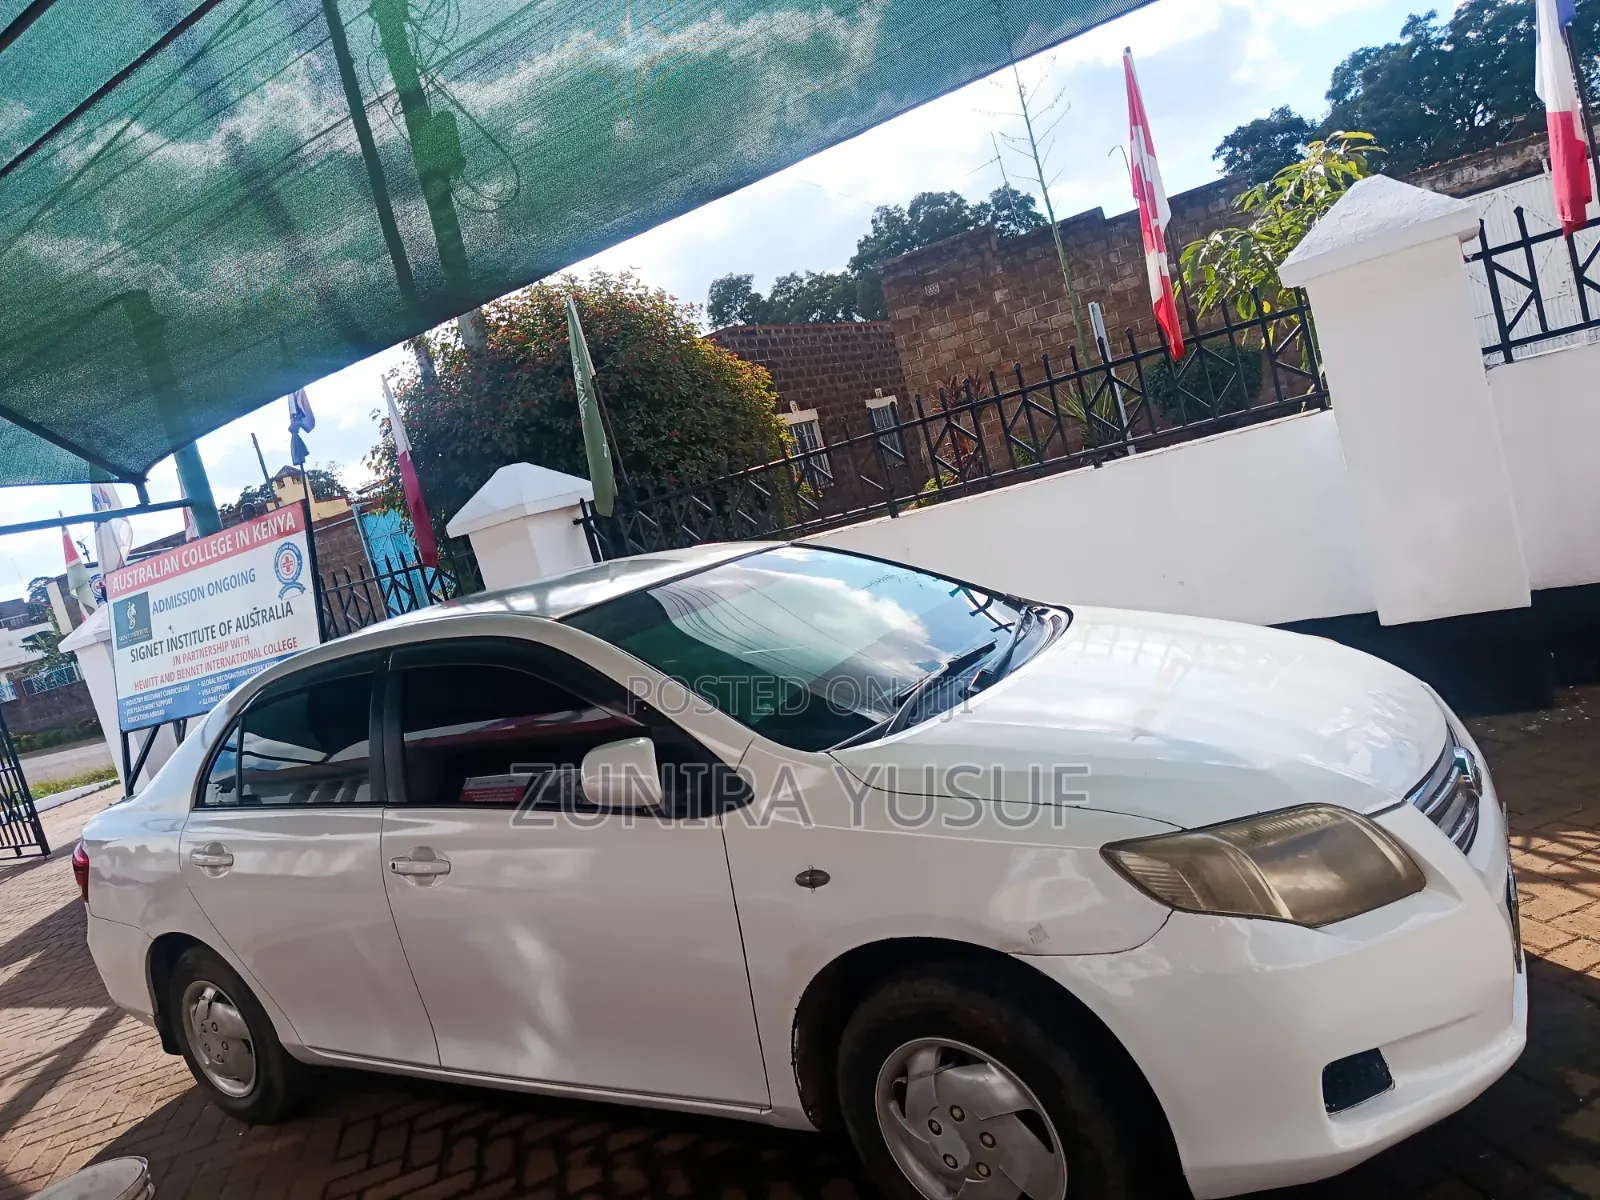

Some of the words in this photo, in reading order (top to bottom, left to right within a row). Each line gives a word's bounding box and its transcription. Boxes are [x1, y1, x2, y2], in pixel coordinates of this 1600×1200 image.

[112, 554, 180, 594] AUSTRALIAN
[181, 533, 233, 568] COLLEGE
[234, 527, 251, 549] IN
[252, 511, 296, 543] KENYA
[152, 586, 205, 615] ADMISSION
[207, 567, 256, 597] ONGOING
[130, 640, 164, 663] SIGNET
[166, 624, 217, 653] INSTITUTE
[218, 619, 233, 636] OF
[235, 600, 294, 633] AUSTRALIA
[172, 655, 182, 666] IN
[182, 641, 229, 664] PARTNERSHIP
[230, 634, 250, 650] WITH
[134, 676, 159, 692] HEWITT
[160, 672, 175, 685] AND
[176, 663, 203, 680] BENNET
[205, 648, 262, 672] INTERNATIONAL
[263, 637, 298, 655] COLLEGE
[201, 678, 216, 687] GLOBAL
[155, 698, 173, 709] SUPPORT
